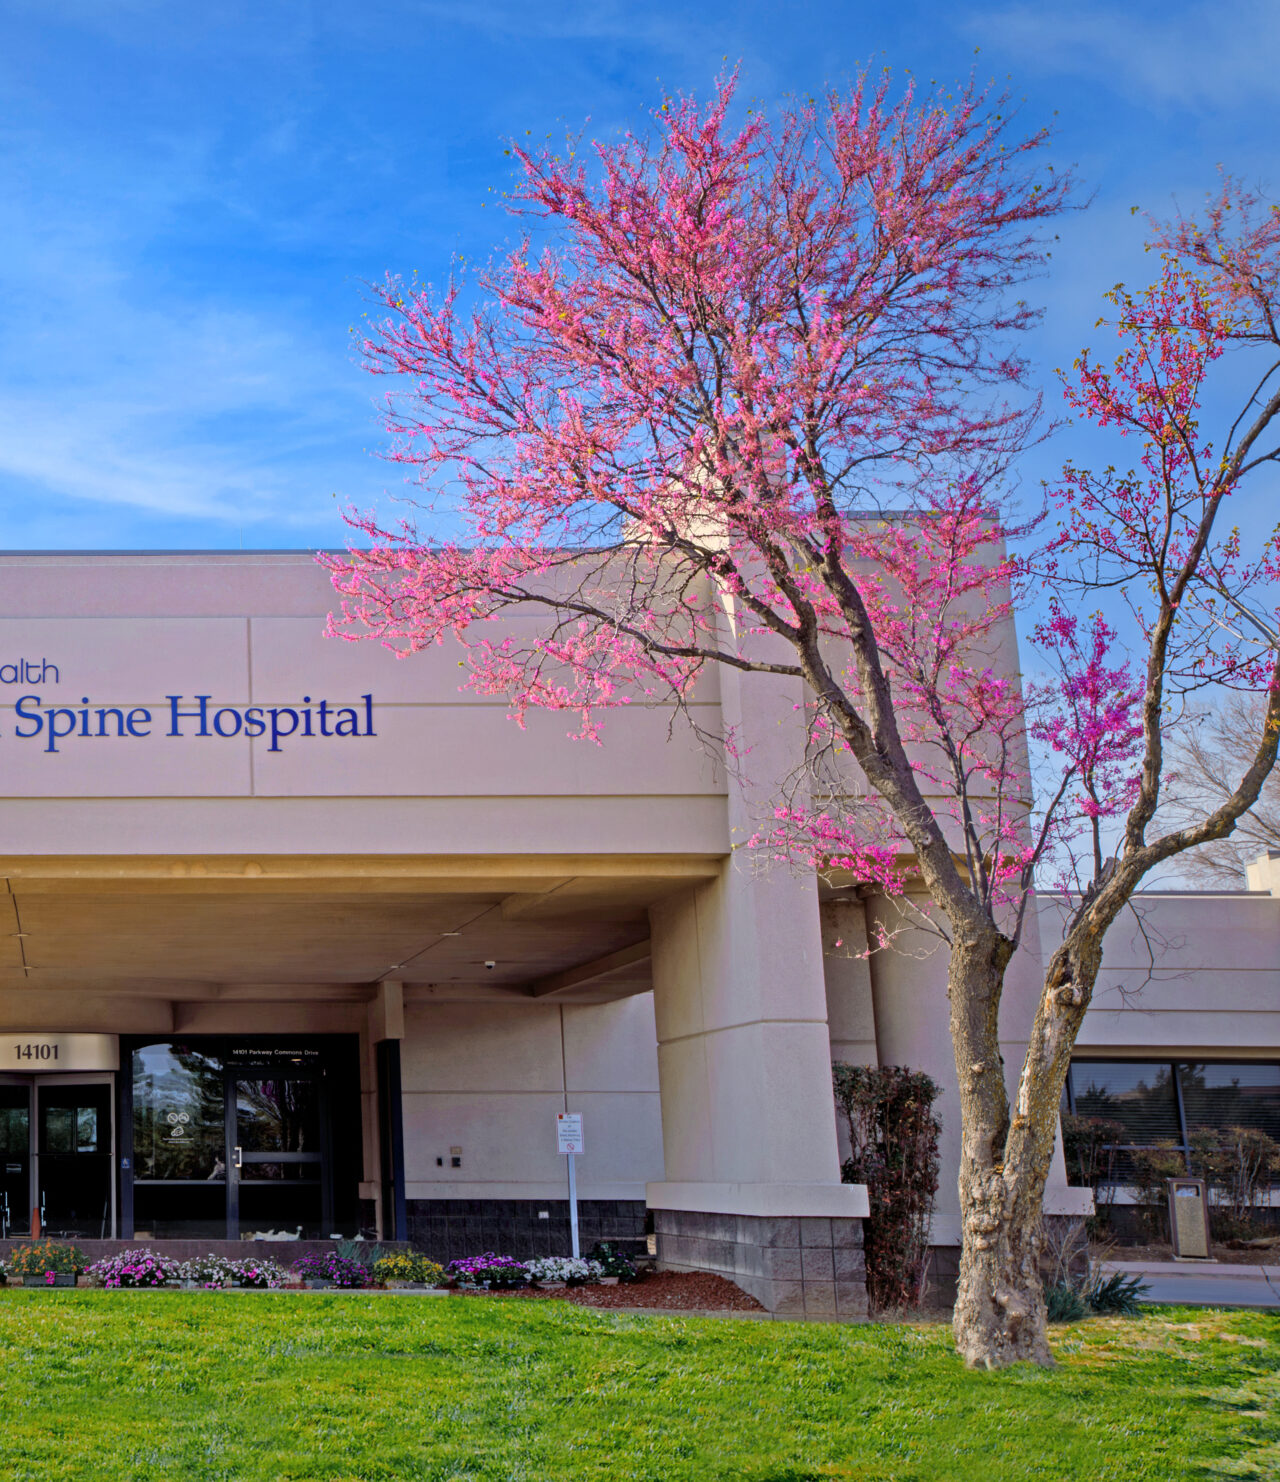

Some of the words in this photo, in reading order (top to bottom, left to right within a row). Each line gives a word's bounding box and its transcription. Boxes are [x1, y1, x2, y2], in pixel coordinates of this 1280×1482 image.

[15, 695, 152, 752] Spine
[165, 694, 377, 752] Hospital
[14, 1044, 58, 1060] 14101
